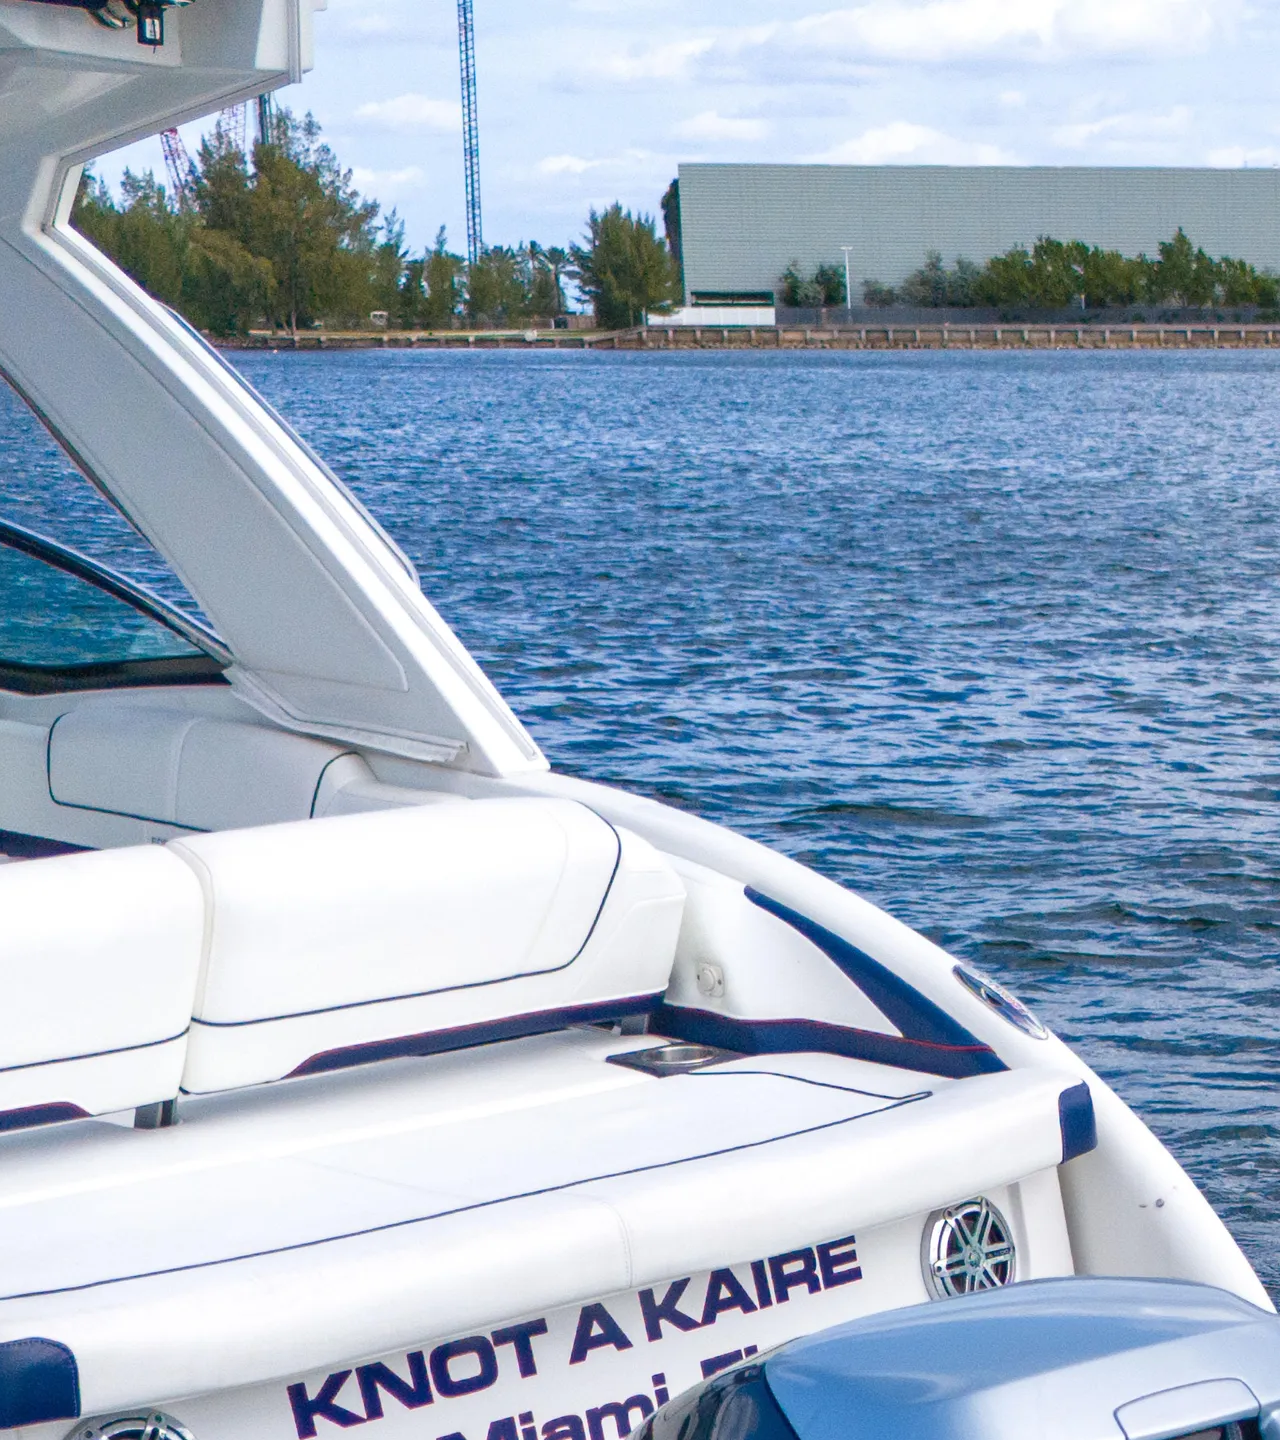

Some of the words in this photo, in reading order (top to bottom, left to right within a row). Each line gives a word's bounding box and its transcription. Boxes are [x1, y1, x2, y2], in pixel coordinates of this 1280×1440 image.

[286, 1318, 548, 1440] KNOT
[569, 1302, 634, 1365] A
[638, 1235, 863, 1342] KAIRE
